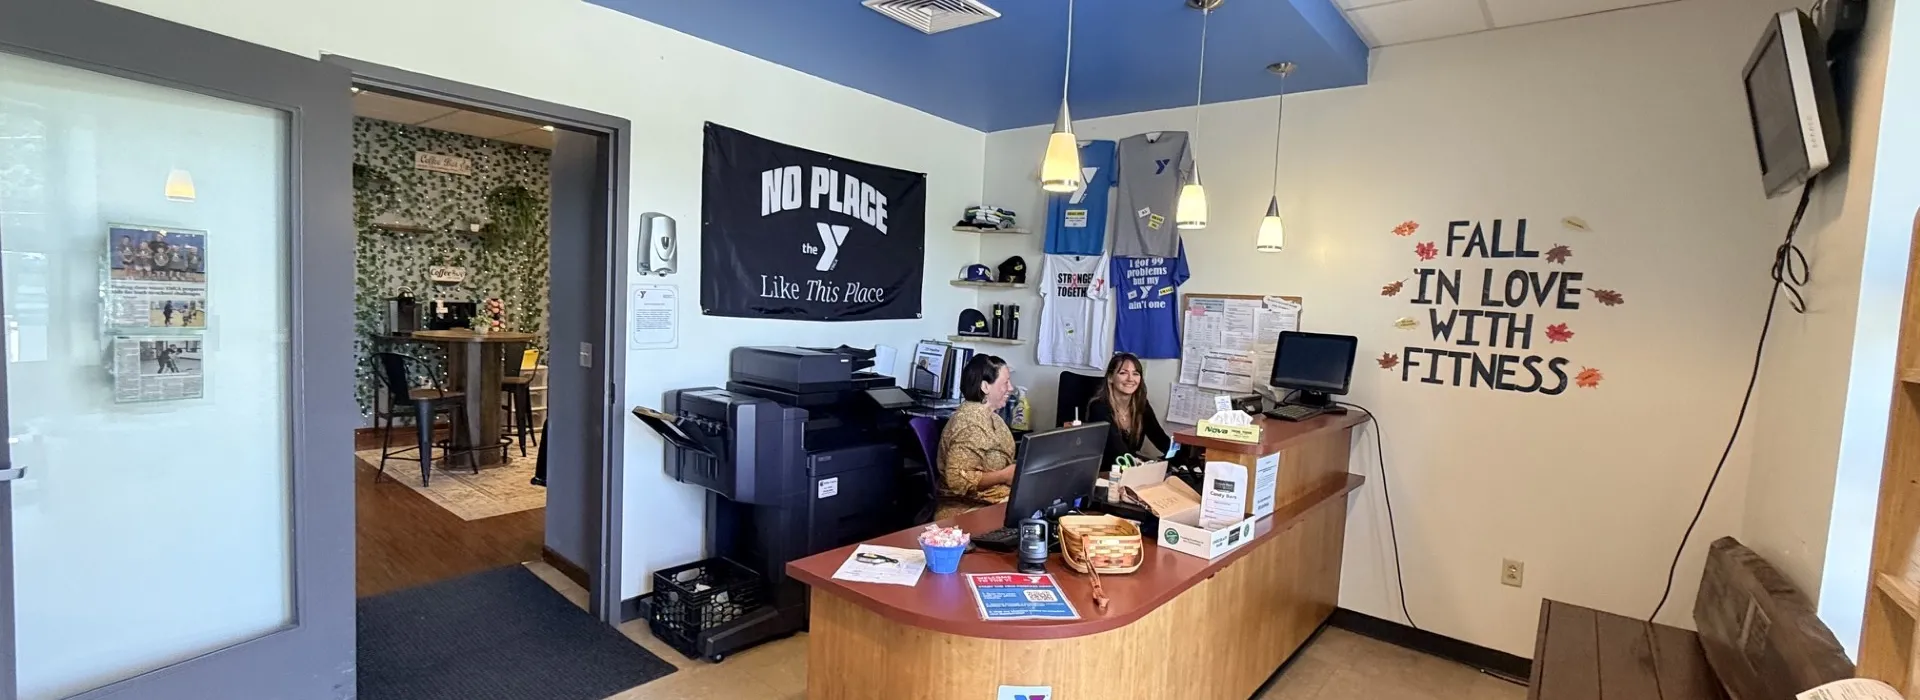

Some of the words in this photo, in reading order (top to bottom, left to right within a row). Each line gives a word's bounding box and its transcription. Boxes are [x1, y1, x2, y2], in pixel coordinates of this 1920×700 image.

[761, 165, 802, 217] NO
[809, 165, 889, 236] PLACE
[1446, 218, 1540, 259] FALL
[802, 243, 818, 256] the
[430, 267, 452, 279] Coffee
[1127, 267, 1168, 279] problems
[1147, 276, 1160, 286] my
[760, 274, 800, 301] Like
[806, 279, 839, 303] This
[843, 282, 885, 303] Place
[1057, 286, 1089, 298] TOGETH
[1411, 268, 1462, 305] IN
[1481, 268, 1584, 310] LOVE
[1148, 300, 1166, 309] one
[1429, 308, 1534, 350] WITH
[1402, 346, 1570, 396] FITNESS
[1205, 426, 1229, 435] Nova
